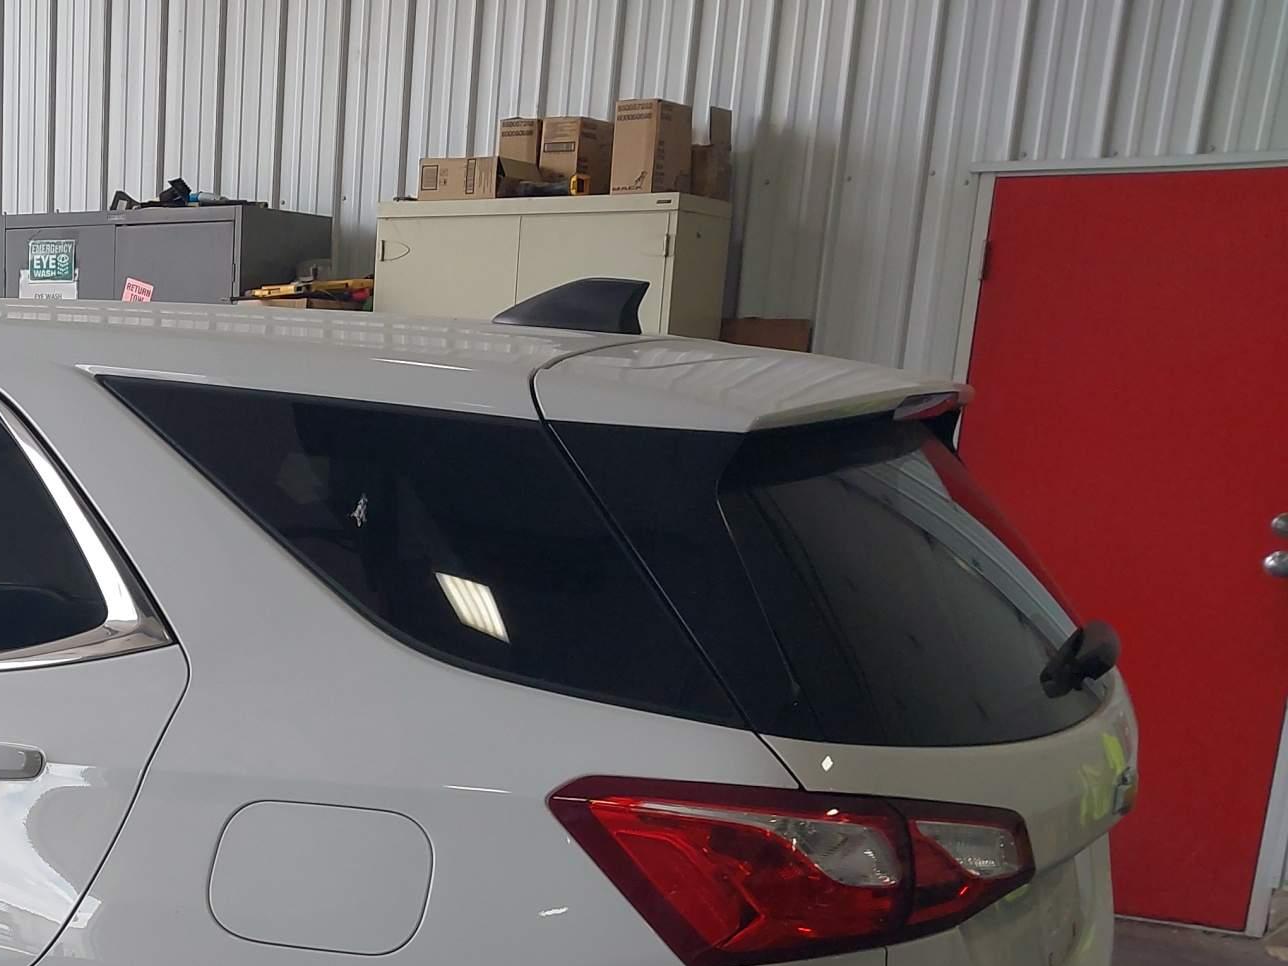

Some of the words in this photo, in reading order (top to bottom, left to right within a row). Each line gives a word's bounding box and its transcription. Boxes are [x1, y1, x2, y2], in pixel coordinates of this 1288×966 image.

[32, 243, 72, 254] EMERGENCY
[33, 254, 57, 269] EYE
[33, 269, 57, 278] WASH
[126, 282, 152, 298] RETURN
